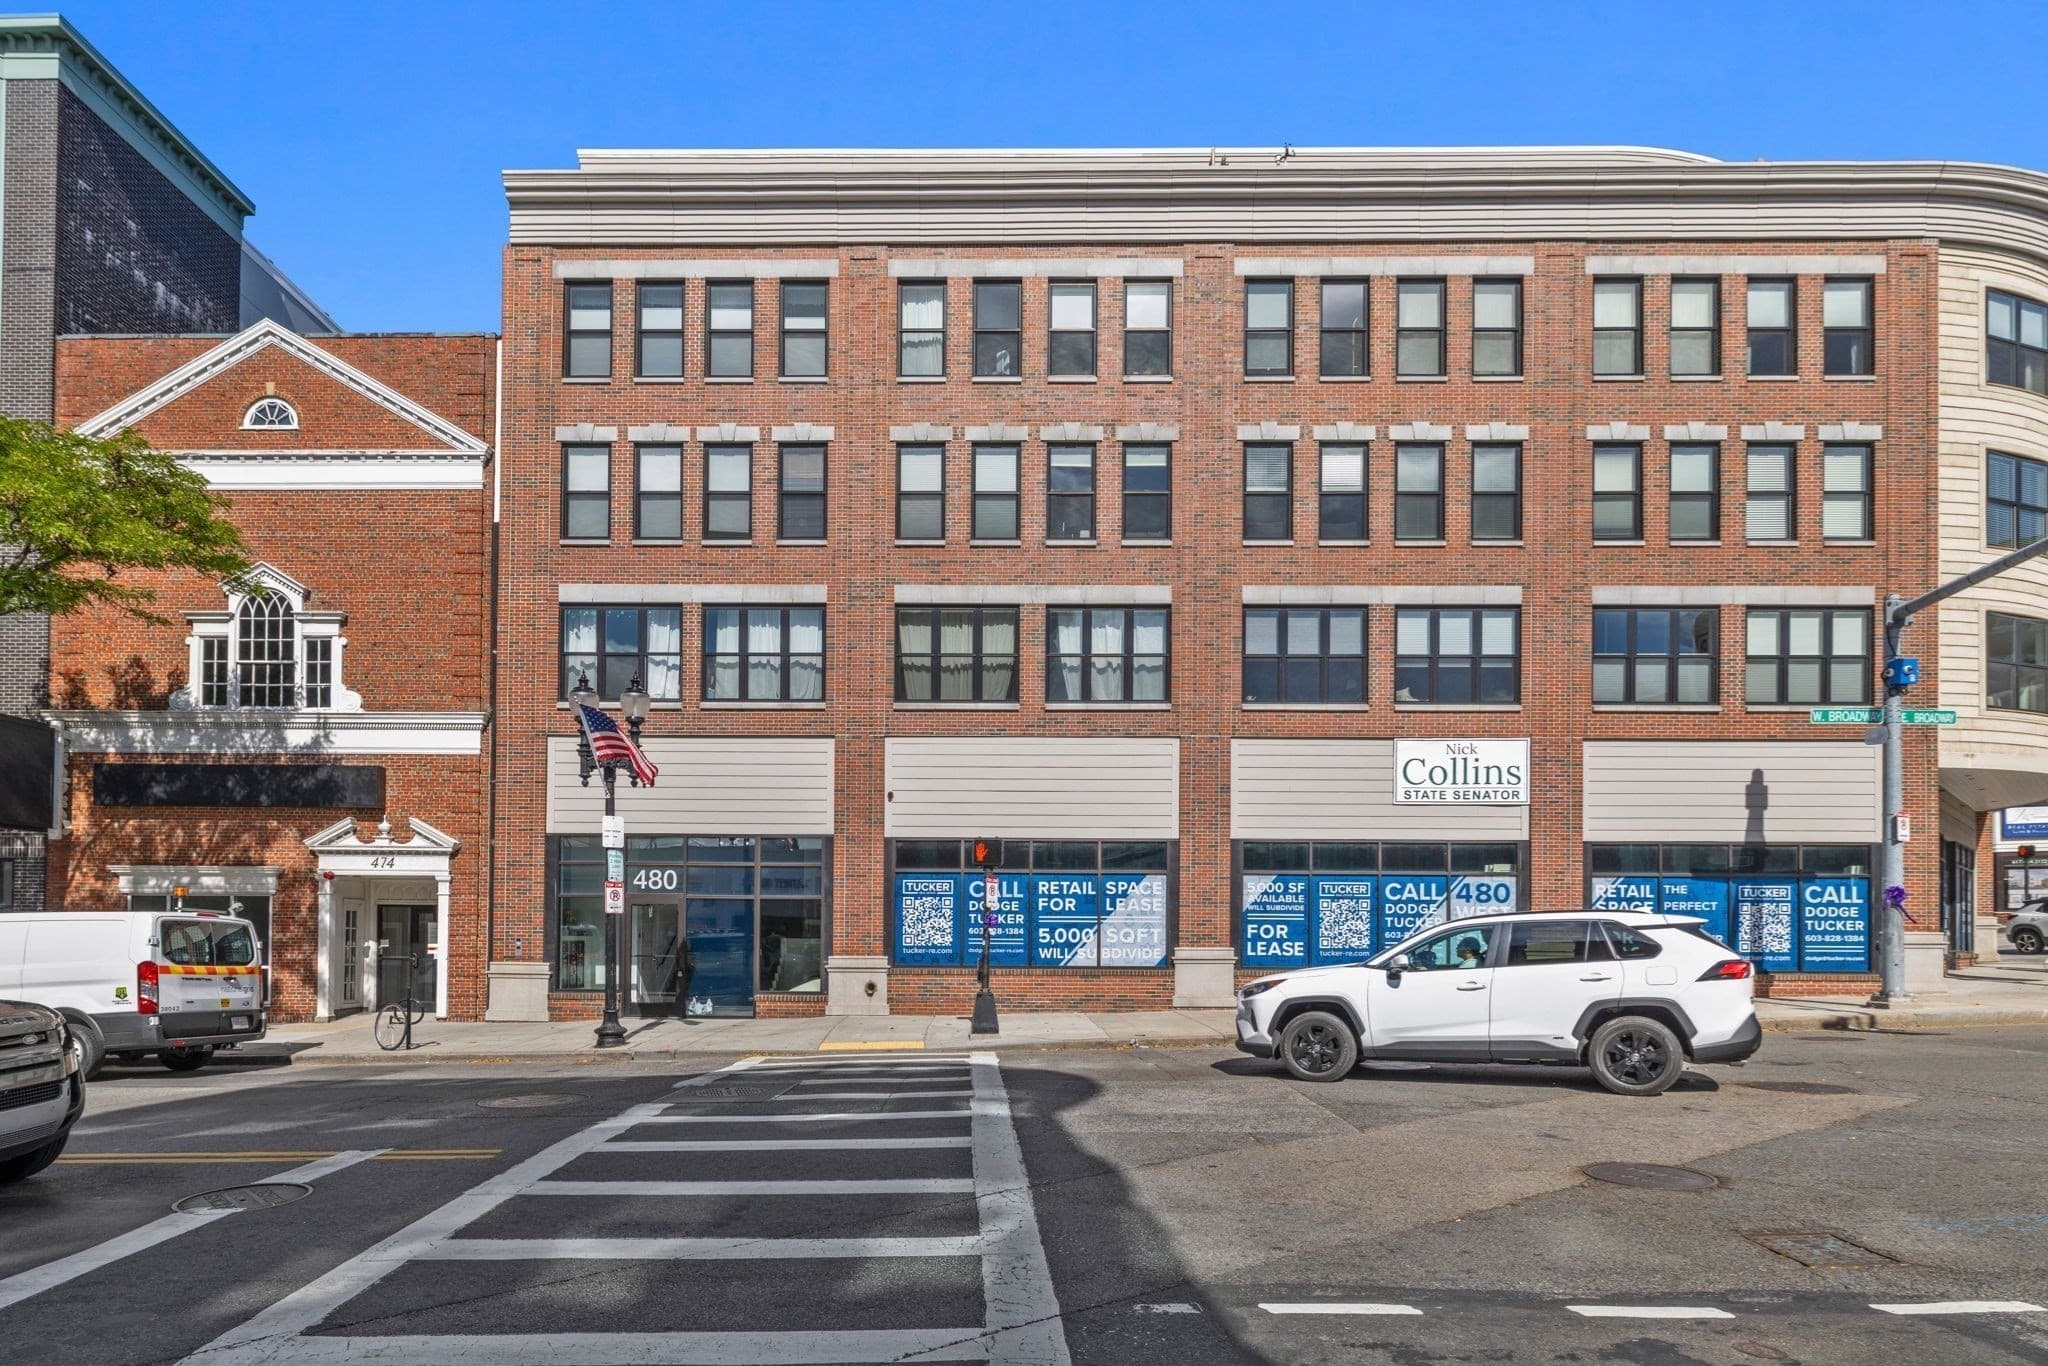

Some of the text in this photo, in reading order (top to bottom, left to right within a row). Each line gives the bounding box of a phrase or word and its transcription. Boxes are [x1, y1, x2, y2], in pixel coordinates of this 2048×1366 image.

[1829, 711, 1880, 721] BROADWAY
[1914, 712, 1954, 723] BROADWAY
[1446, 743, 1479, 755] Nick
[1403, 757, 1521, 785] Collins
[1404, 790, 1520, 800] STATE SENATOR
[371, 857, 394, 868] 474
[633, 869, 677, 889] 480
[907, 883, 950, 891] TUCKER
[969, 881, 1023, 898] CLL
[1039, 882, 1162, 894] RETAIL SPACE
[1288, 882, 1304, 893] SF
[1323, 885, 1367, 893] TUCKER
[1385, 883, 1441, 900] CALL
[1595, 885, 1655, 898] RETAIL
[1663, 885, 1688, 894] THE
[1456, 883, 1510, 903] 480
[1743, 889, 1787, 897] TUCKER
[1805, 886, 1864, 903] CALL
[1039, 898, 1162, 910] FOR LEASE
[1248, 895, 1304, 903] AVAILABLE
[1385, 904, 1438, 914] DODGE
[1664, 902, 1718, 910] PERFECT
[1805, 907, 1859, 917] DODGE
[969, 914, 1024, 924] TUKER
[1805, 920, 1864, 930] TUCKER
[1039, 928, 1161, 945] 5,000 SQFT
[1247, 925, 1288, 938] FOR
[1039, 948, 1071, 958] WILL
[1247, 942, 1304, 956] LEASE
